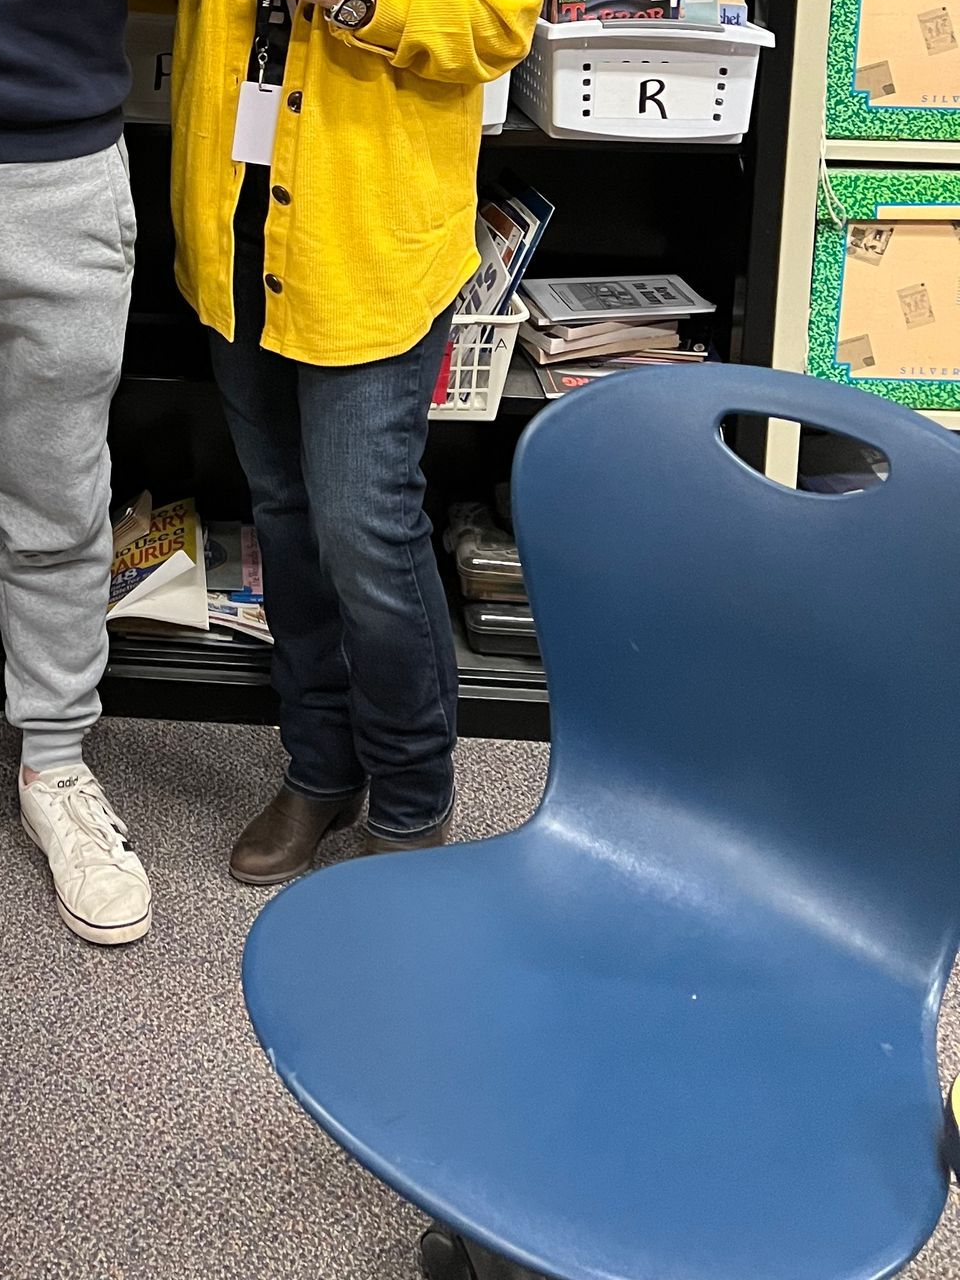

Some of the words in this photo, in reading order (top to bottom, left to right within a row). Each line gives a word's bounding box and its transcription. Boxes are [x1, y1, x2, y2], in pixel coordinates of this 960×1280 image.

[638, 78, 668, 120] R
[494, 338, 508, 353] A
[134, 531, 172, 550] Use
[112, 537, 186, 578] AURUS
[57, 776, 80, 790] adid
